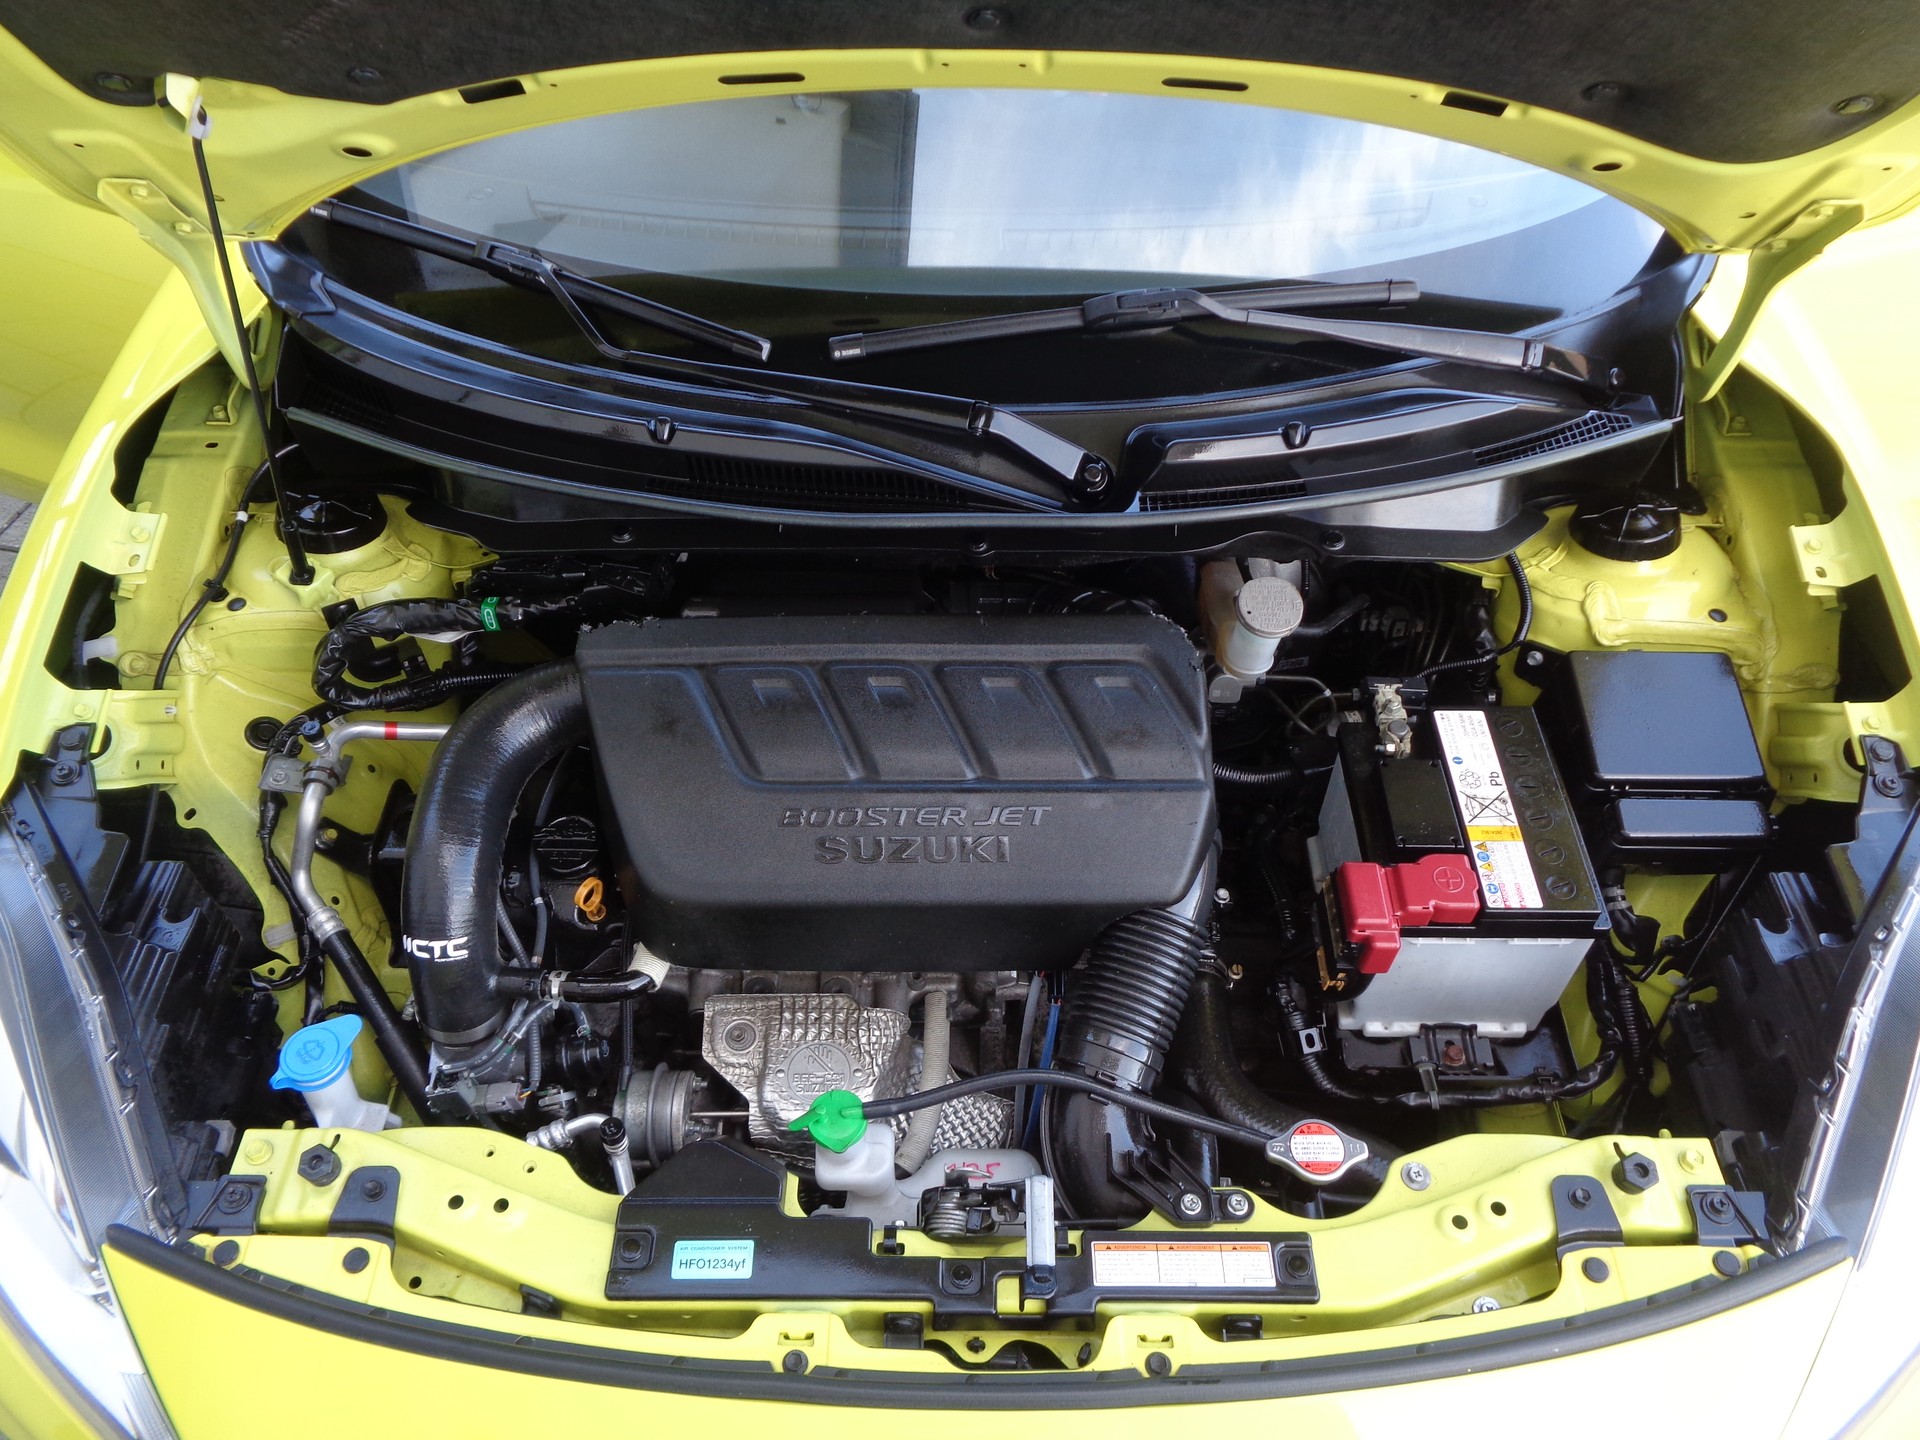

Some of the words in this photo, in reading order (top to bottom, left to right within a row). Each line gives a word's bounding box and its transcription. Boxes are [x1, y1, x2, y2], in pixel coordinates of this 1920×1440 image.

[1488, 771, 1503, 786] Pb
[778, 806, 967, 828] BOOSTER
[973, 805, 1052, 827] JET
[814, 834, 1010, 865] SUZUKI
[679, 1258, 746, 1271] HFO1234yf
